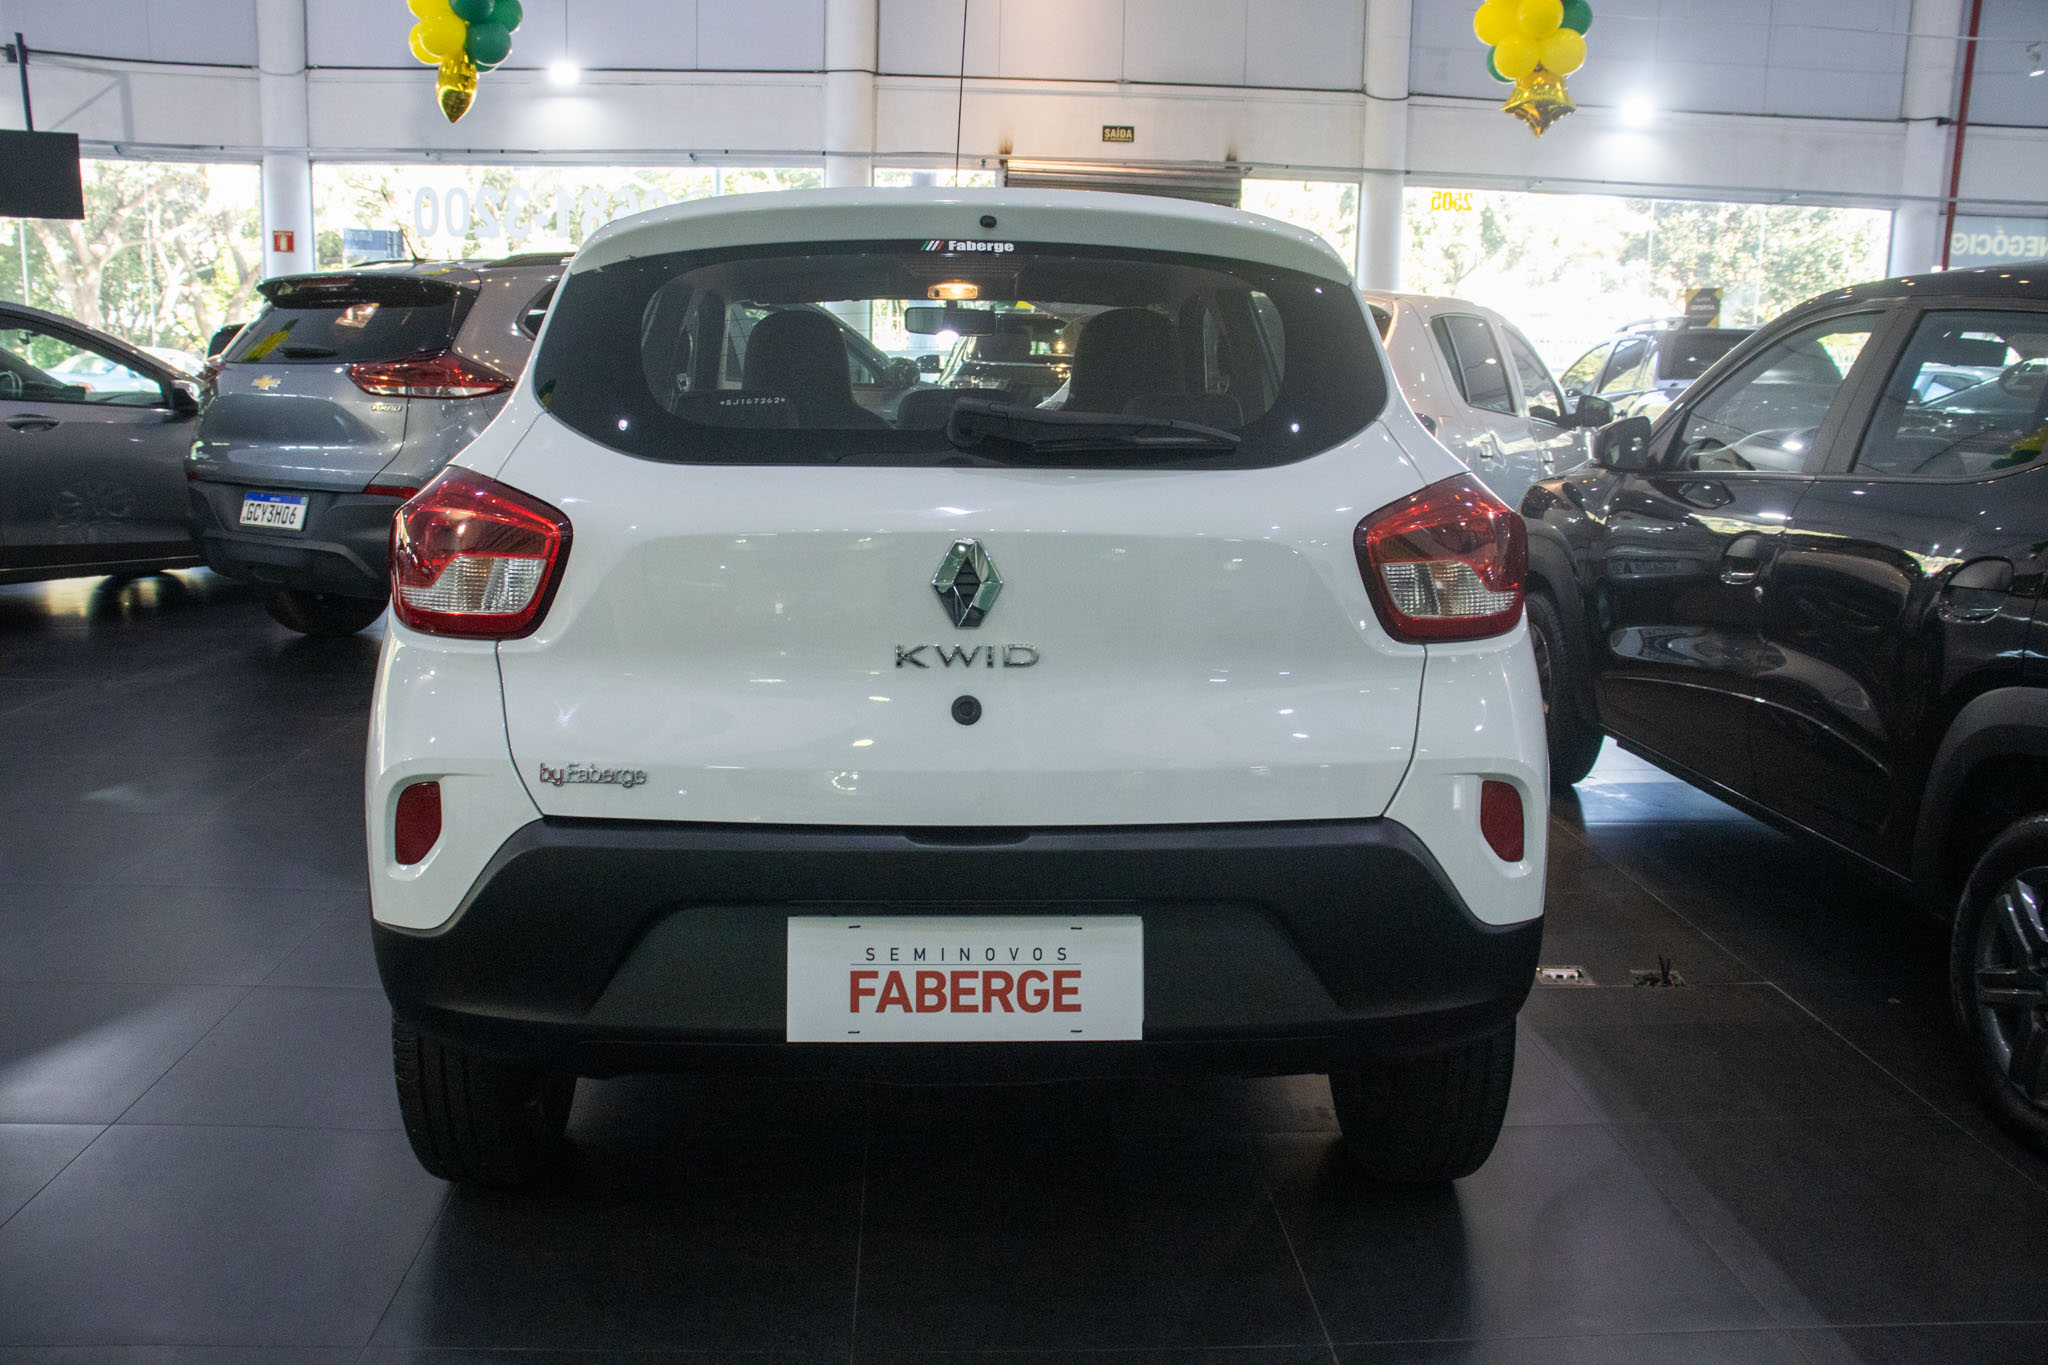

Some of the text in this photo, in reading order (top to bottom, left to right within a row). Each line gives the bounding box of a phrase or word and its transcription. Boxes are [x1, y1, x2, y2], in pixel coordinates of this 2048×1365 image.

[948, 240, 1015, 253] Faberge
[246, 502, 297, 525] GCY3H06
[895, 644, 1040, 668] KWID
[540, 763, 564, 787] by
[865, 947, 1068, 962] SEMINOVOS
[849, 969, 1083, 1014] FABERGE
